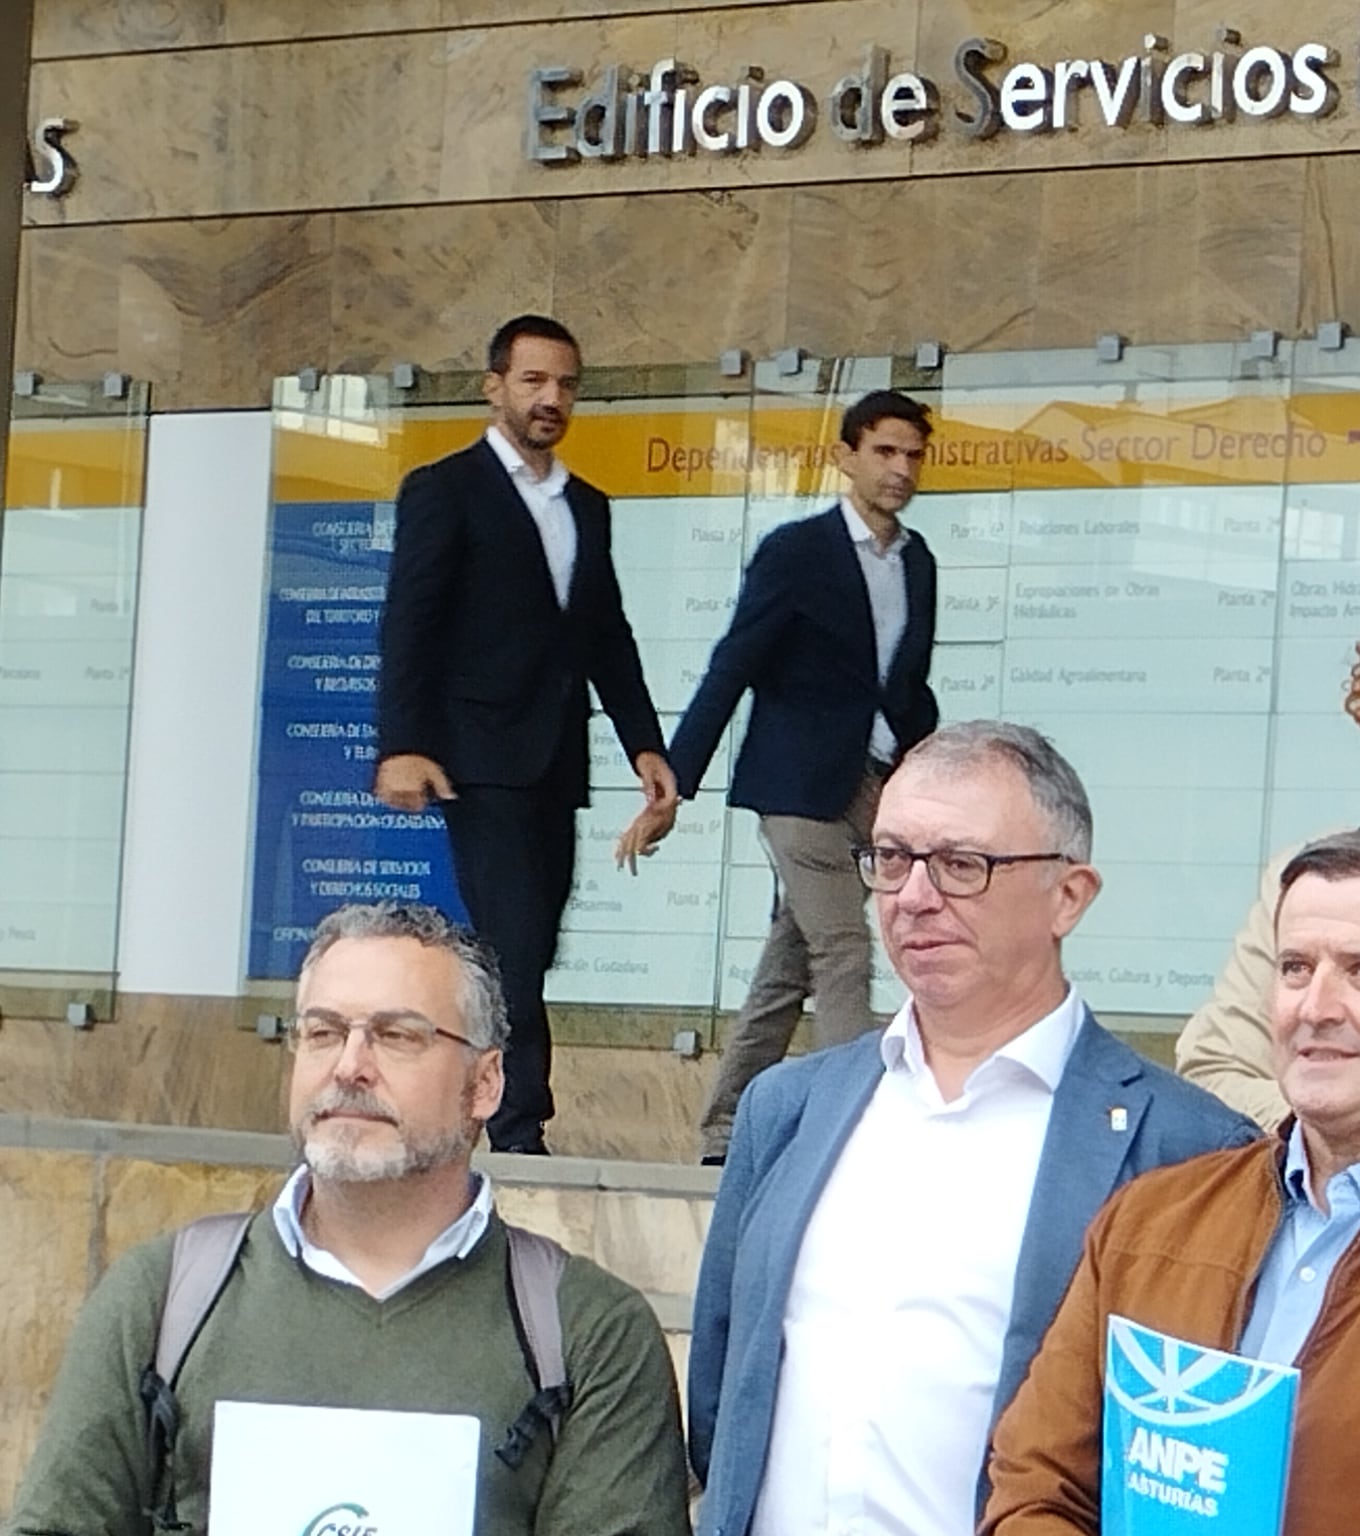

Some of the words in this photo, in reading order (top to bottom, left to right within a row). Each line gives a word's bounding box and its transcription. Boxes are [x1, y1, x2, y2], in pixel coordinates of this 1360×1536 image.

[527, 58, 815, 166] Edificio
[828, 42, 937, 152] de
[954, 34, 1330, 140] Servicios
[645, 436, 841, 482] Dependencias
[924, 436, 1070, 470] nistrativas
[1080, 427, 1182, 463] Sector
[1191, 423, 1328, 461] Derecho
[1109, 967, 1150, 984] Cultura
[1168, 969, 1215, 987] Deporte
[1127, 1426, 1229, 1494] ANPE
[1127, 1471, 1219, 1518] ASTURIAS
